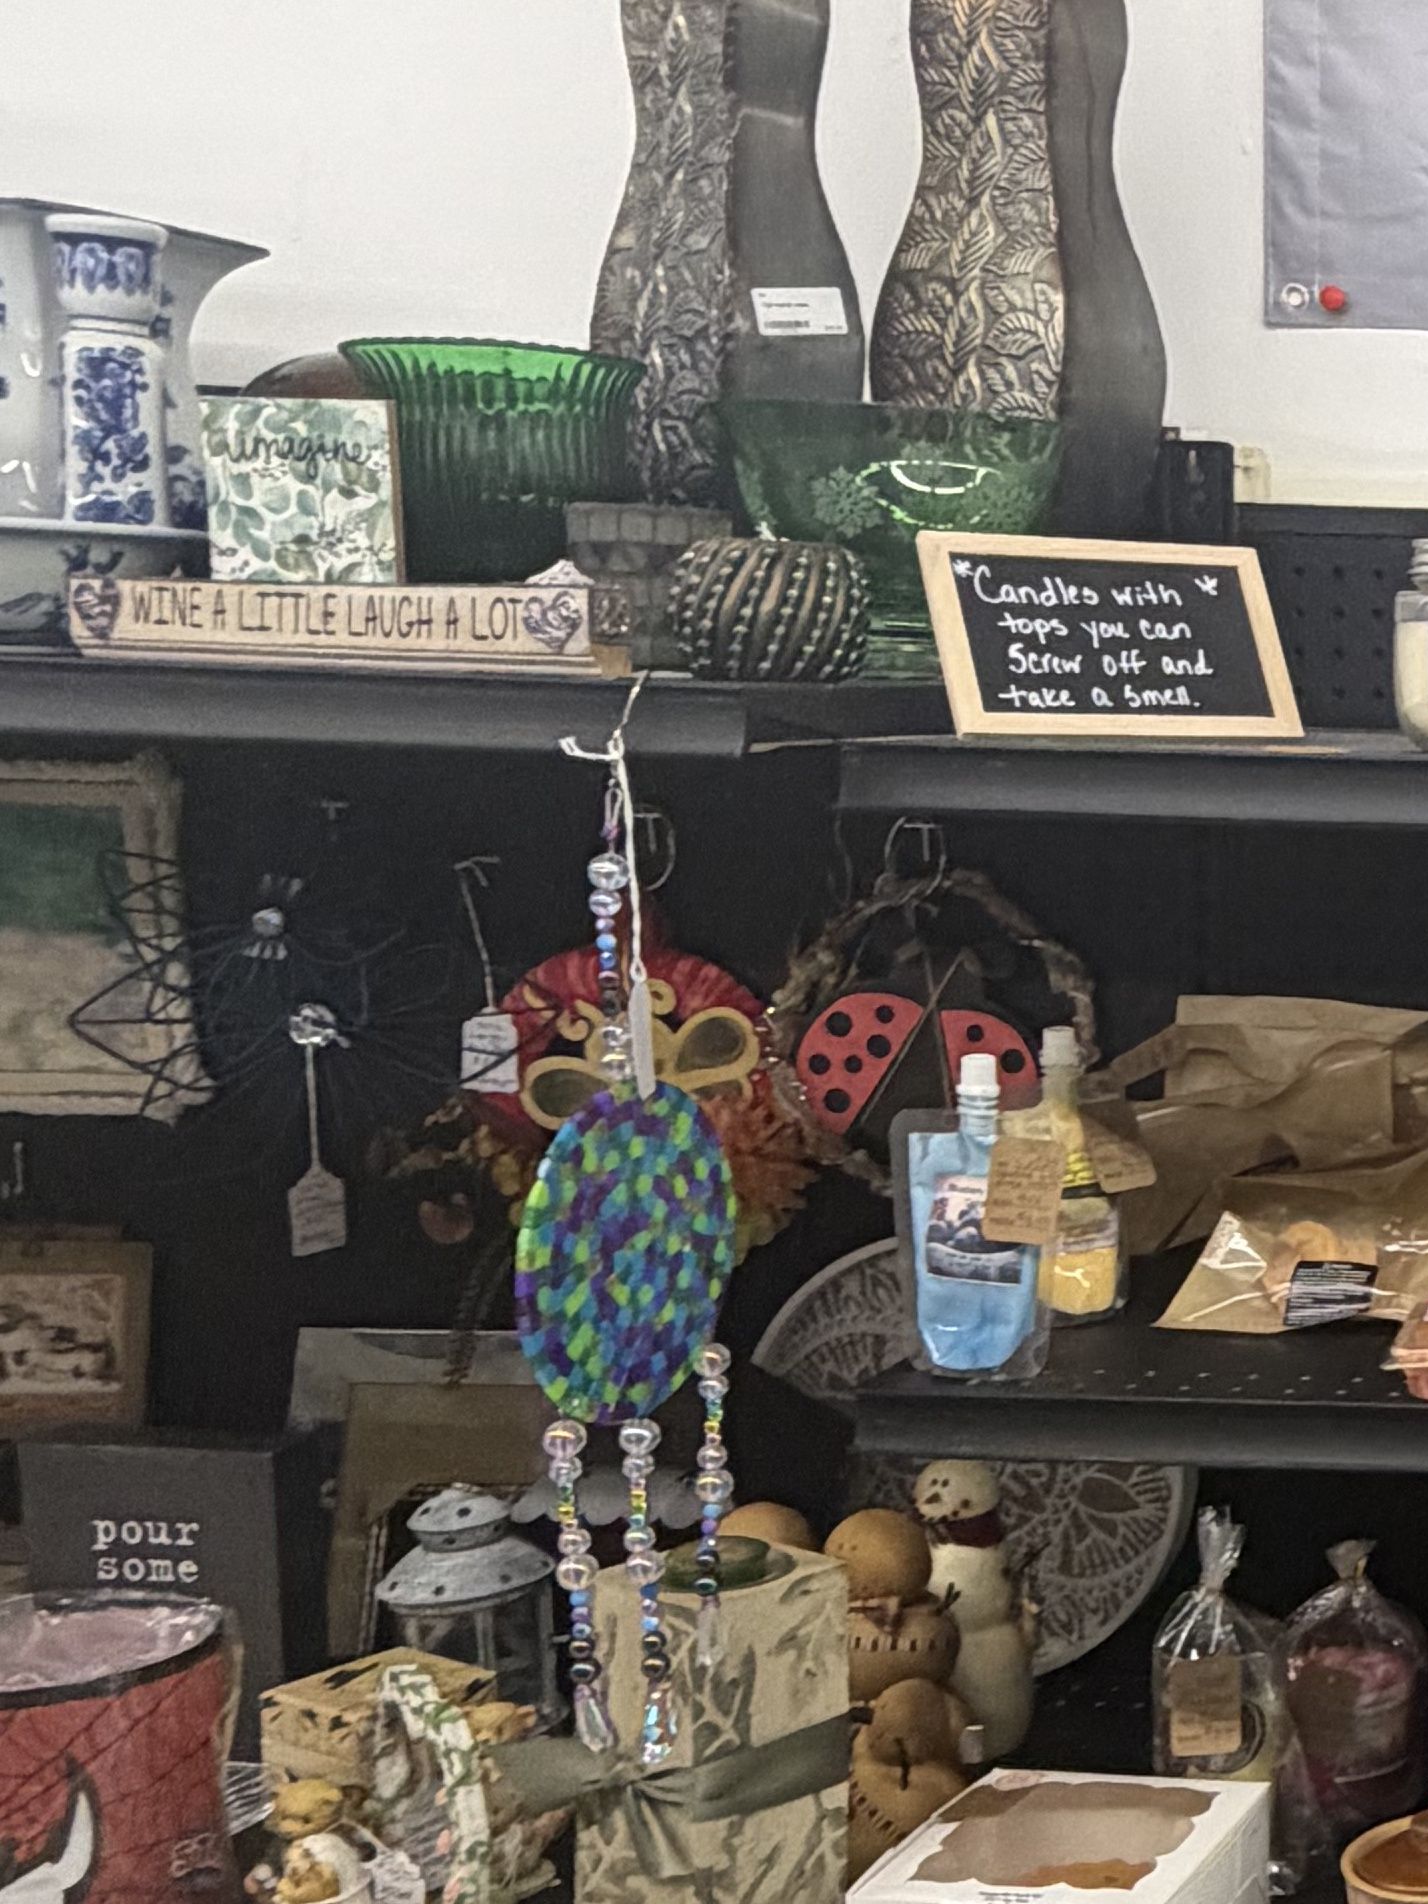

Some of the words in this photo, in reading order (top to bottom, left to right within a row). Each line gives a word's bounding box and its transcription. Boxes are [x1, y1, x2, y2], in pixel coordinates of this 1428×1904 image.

[973, 565, 1099, 608] Candles
[1110, 582, 1182, 608] with
[133, 587, 203, 629] WINE
[212, 590, 226, 627] A
[237, 591, 337, 636] LITTLE
[347, 595, 432, 638] LAUGH
[445, 600, 459, 640] A
[470, 597, 523, 641] LOT
[998, 614, 1069, 643] tops
[1081, 617, 1131, 647] you
[1139, 618, 1192, 639] can
[1101, 651, 1147, 677] off
[1161, 651, 1214, 677] and
[998, 684, 1075, 708] take
[1091, 688, 1114, 707] a
[91, 1517, 200, 1551] pour
[97, 1553, 200, 1582] some
